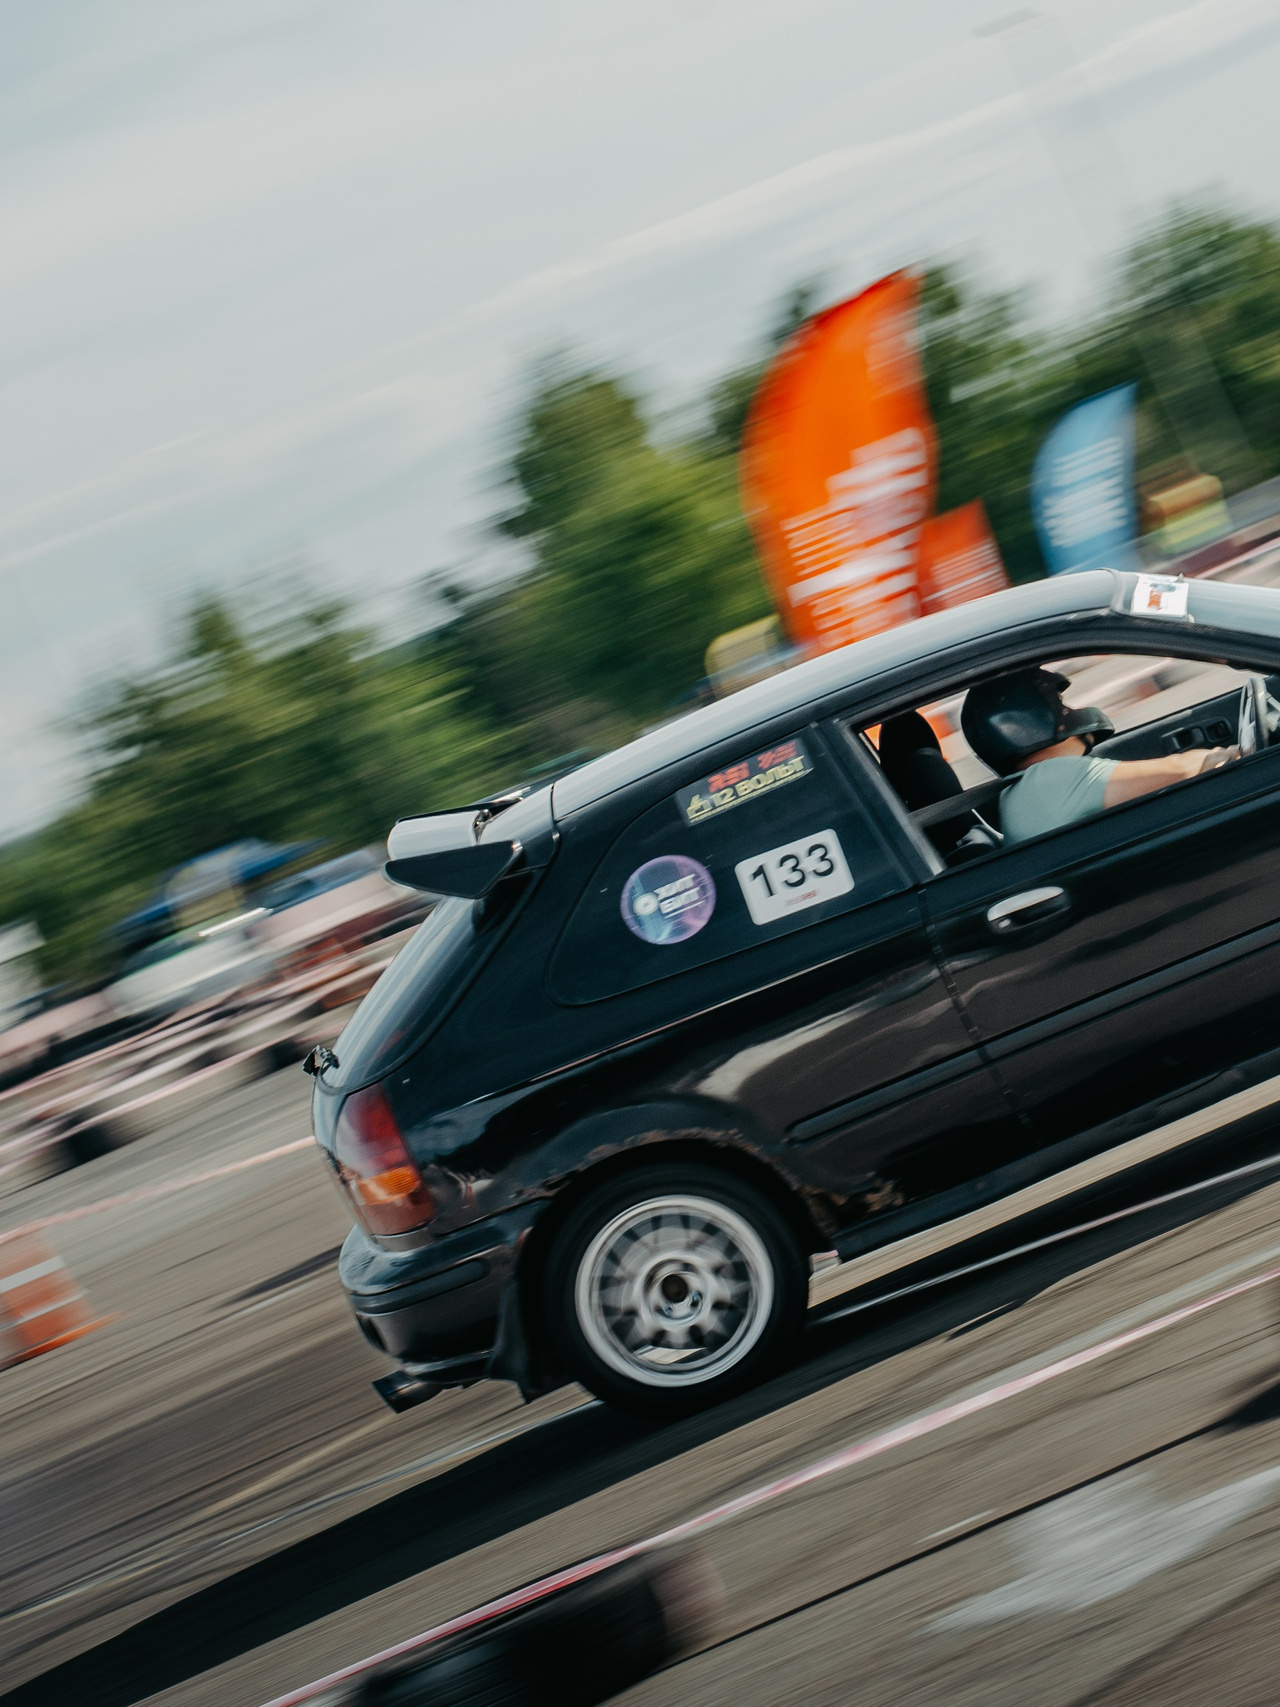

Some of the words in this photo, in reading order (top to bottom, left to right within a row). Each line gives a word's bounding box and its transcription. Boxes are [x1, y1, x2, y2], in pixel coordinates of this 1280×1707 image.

[710, 787, 736, 808] 12
[735, 755, 805, 797] ВОЛЬТ
[749, 843, 834, 898] 133
